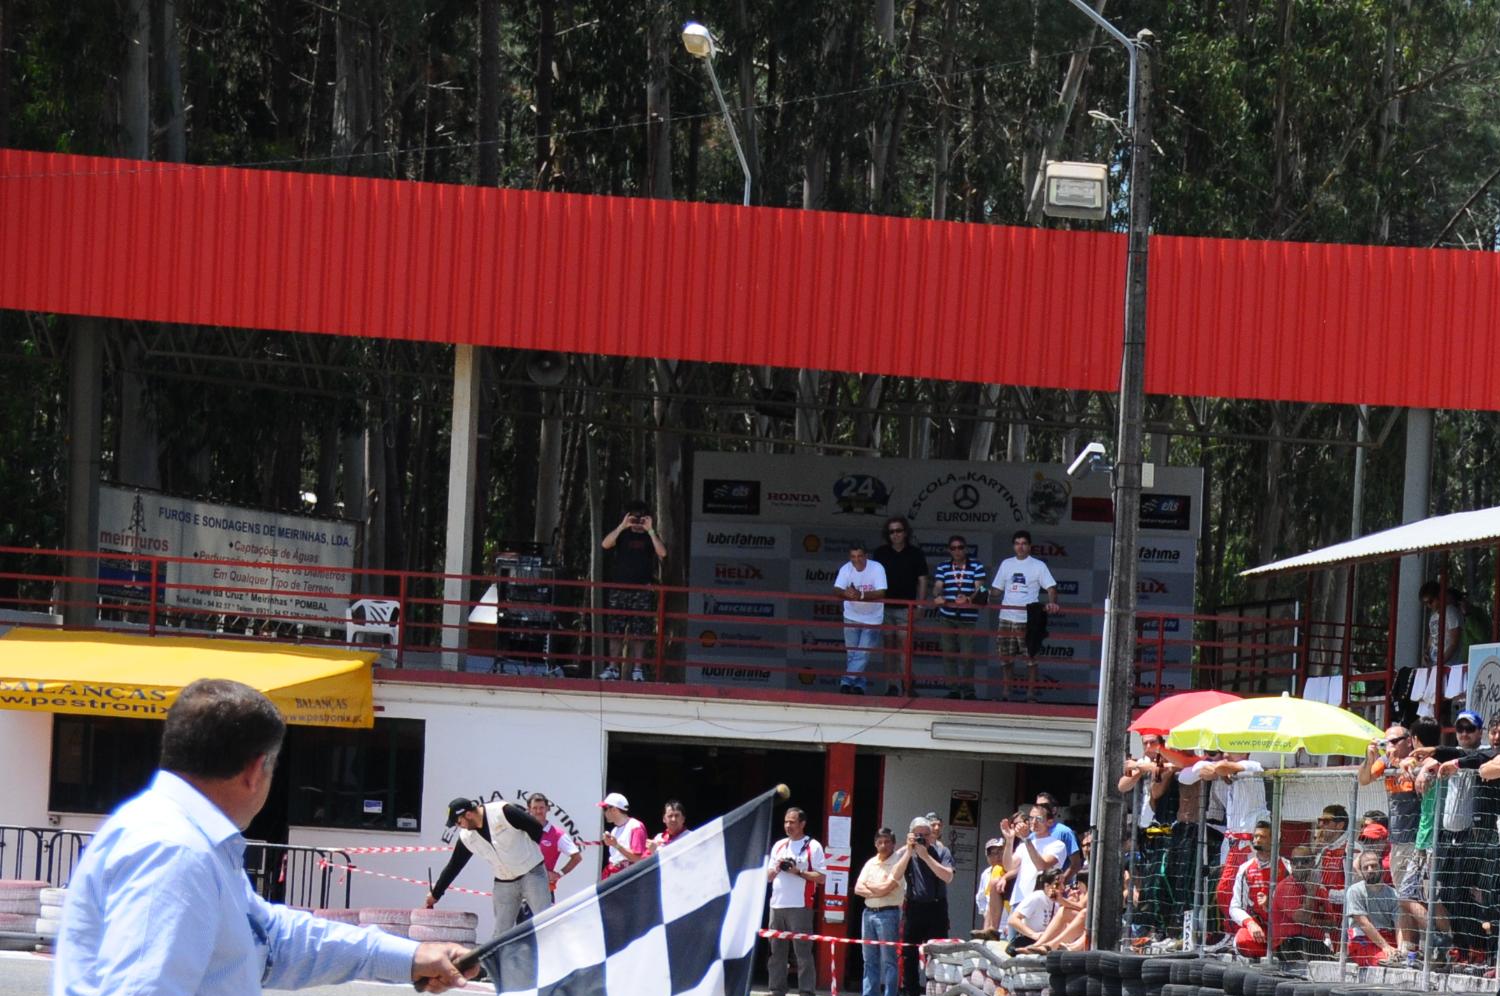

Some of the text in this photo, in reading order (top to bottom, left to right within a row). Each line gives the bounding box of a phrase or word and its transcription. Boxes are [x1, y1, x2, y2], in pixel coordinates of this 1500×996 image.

[767, 492, 821, 502] HONDA
[841, 476, 874, 497] 24
[907, 473, 957, 521] ESCOLA
[967, 472, 1024, 522] KARTING
[159, 507, 191, 523] FUROS
[194, 514, 200, 525] E
[202, 516, 260, 534] SONDAGENS
[263, 525, 275, 537] DE
[278, 527, 329, 546] MEIRINHAS,
[937, 511, 998, 522] EUROINDY
[234, 541, 319, 563] Captações de Águas
[213, 568, 334, 594] Em Qualquer Tipo de Terreno
[714, 564, 763, 579] HELIX
[225, 590, 243, 600] Cruz
[251, 593, 287, 606] Meirinhas
[295, 600, 328, 612] POMBAL
[718, 604, 772, 614] MICHELIN
[295, 697, 348, 712] BALANÇAS
